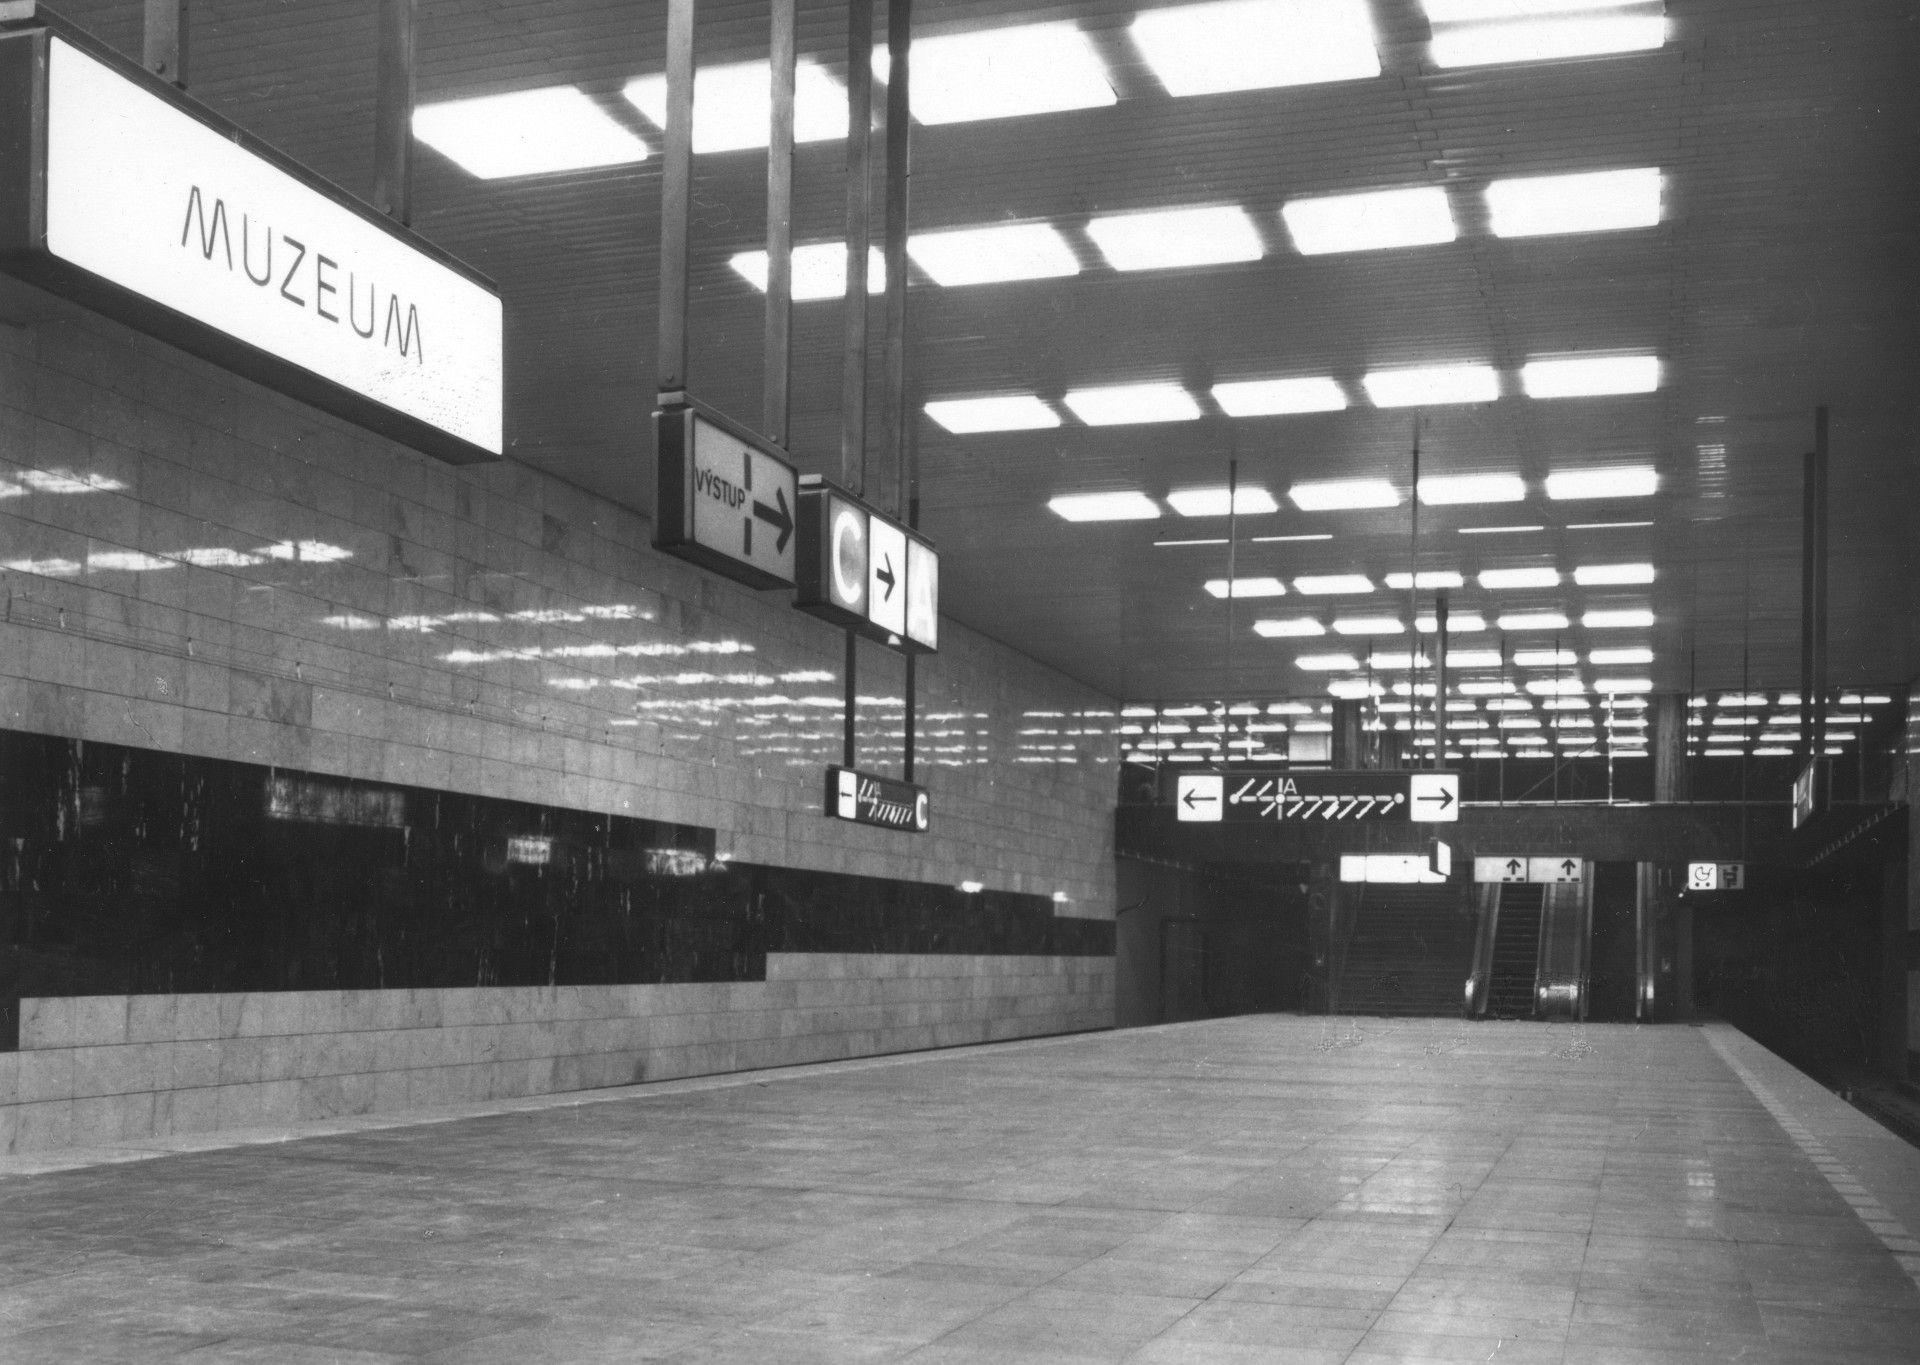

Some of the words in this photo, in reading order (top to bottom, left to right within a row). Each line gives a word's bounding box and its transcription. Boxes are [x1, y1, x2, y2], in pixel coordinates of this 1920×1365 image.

[181, 184, 422, 365] MUZEUM
[695, 467, 745, 510] VÝSTUP
[832, 511, 861, 604] C
[1283, 778, 1297, 794] A
[916, 793, 928, 829] C
